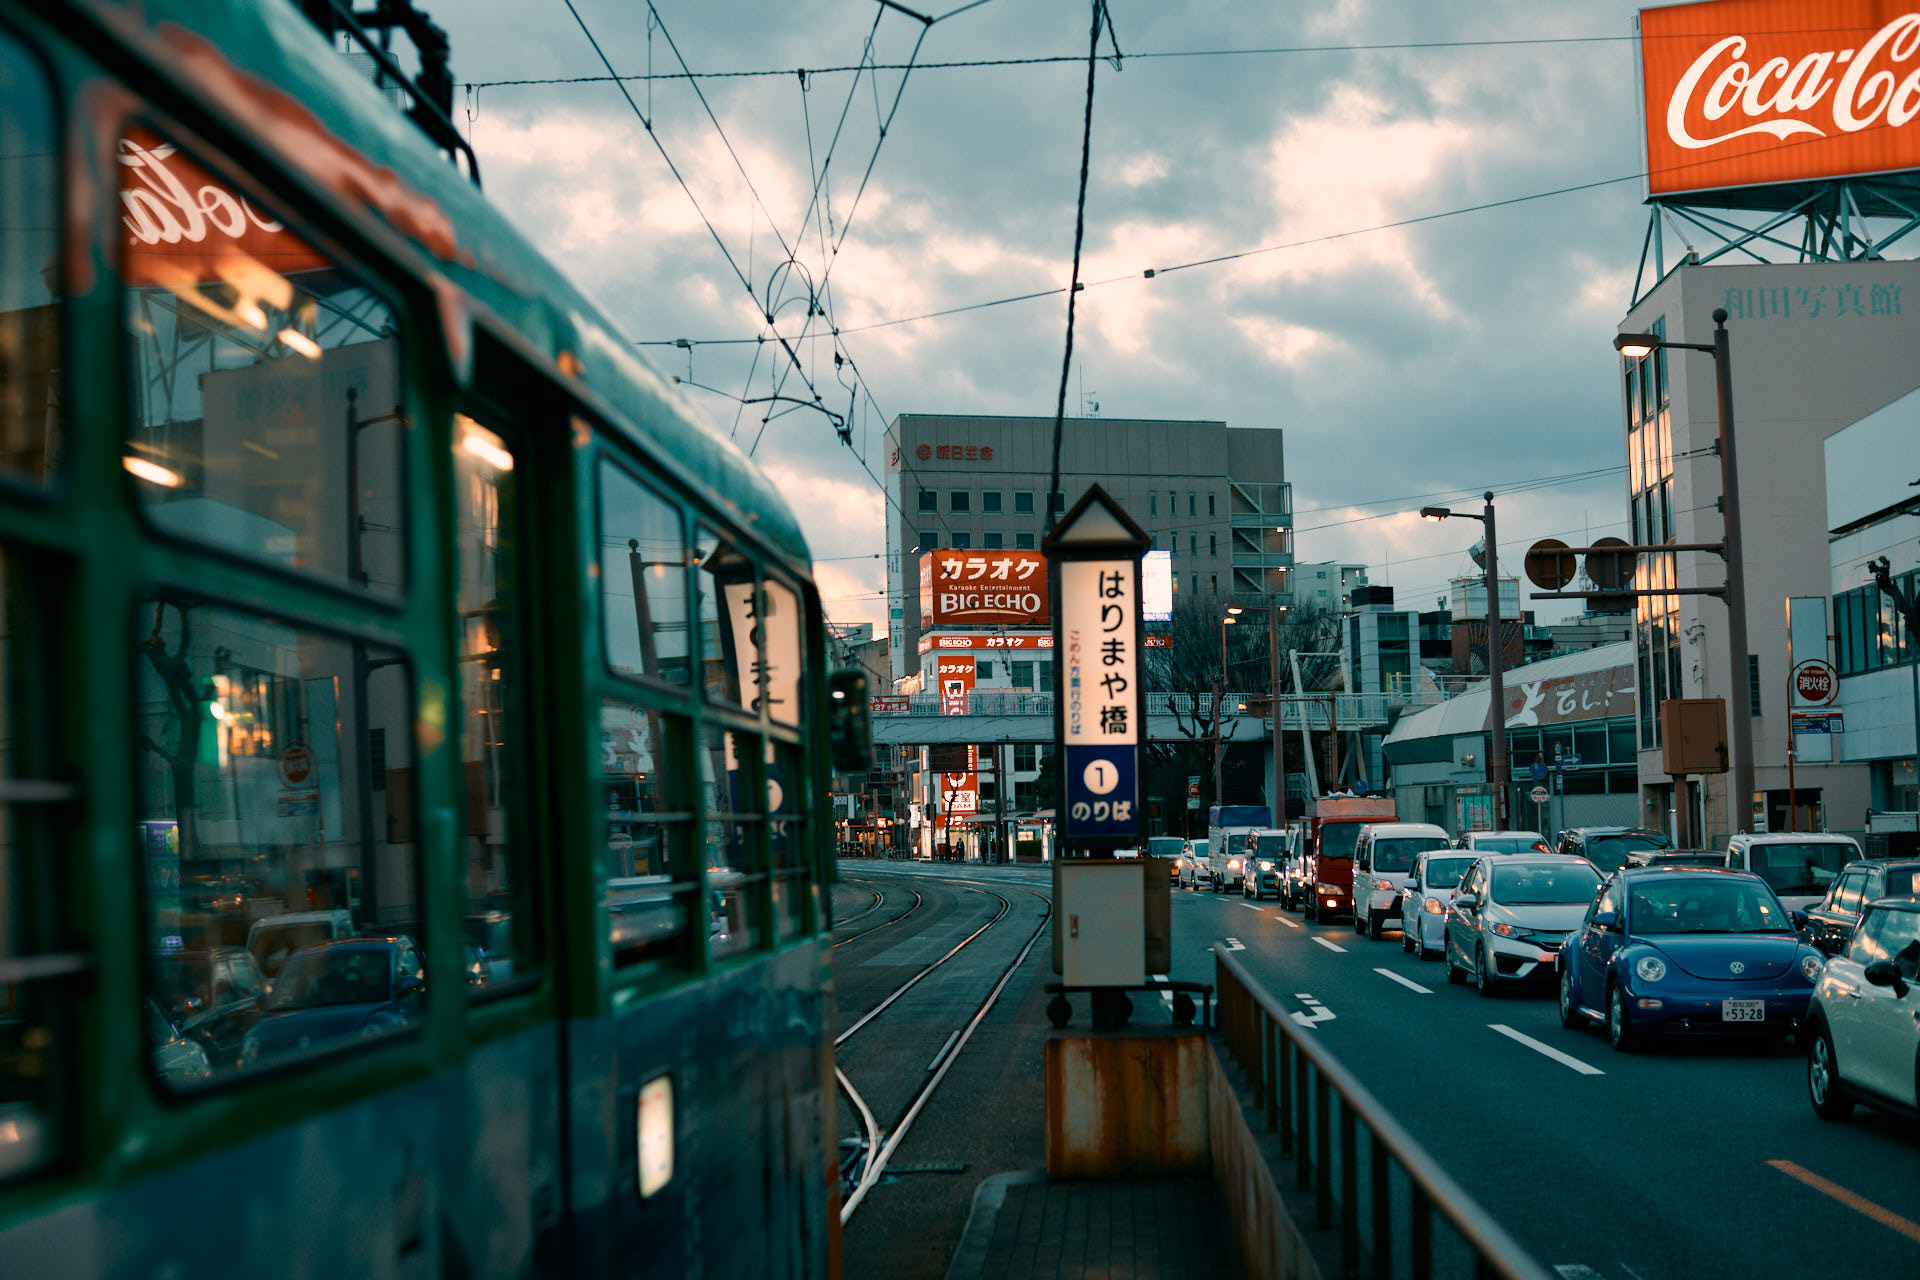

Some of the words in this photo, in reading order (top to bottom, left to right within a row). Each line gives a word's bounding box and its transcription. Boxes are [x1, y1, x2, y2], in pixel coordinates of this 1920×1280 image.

[1720, 283, 1903, 320] 和田写真館
[940, 557, 1039, 580] カラオケ
[940, 593, 980, 614] BIG
[984, 593, 1041, 613] ECHO
[986, 637, 1025, 647] カラオケ
[1099, 570, 1128, 735] はりまや橋
[939, 665, 974, 674] カラオケ
[1799, 676, 1829, 691] 消火栓
[1071, 801, 1132, 822] のりば
[1731, 1008, 1763, 1020] 53-28
